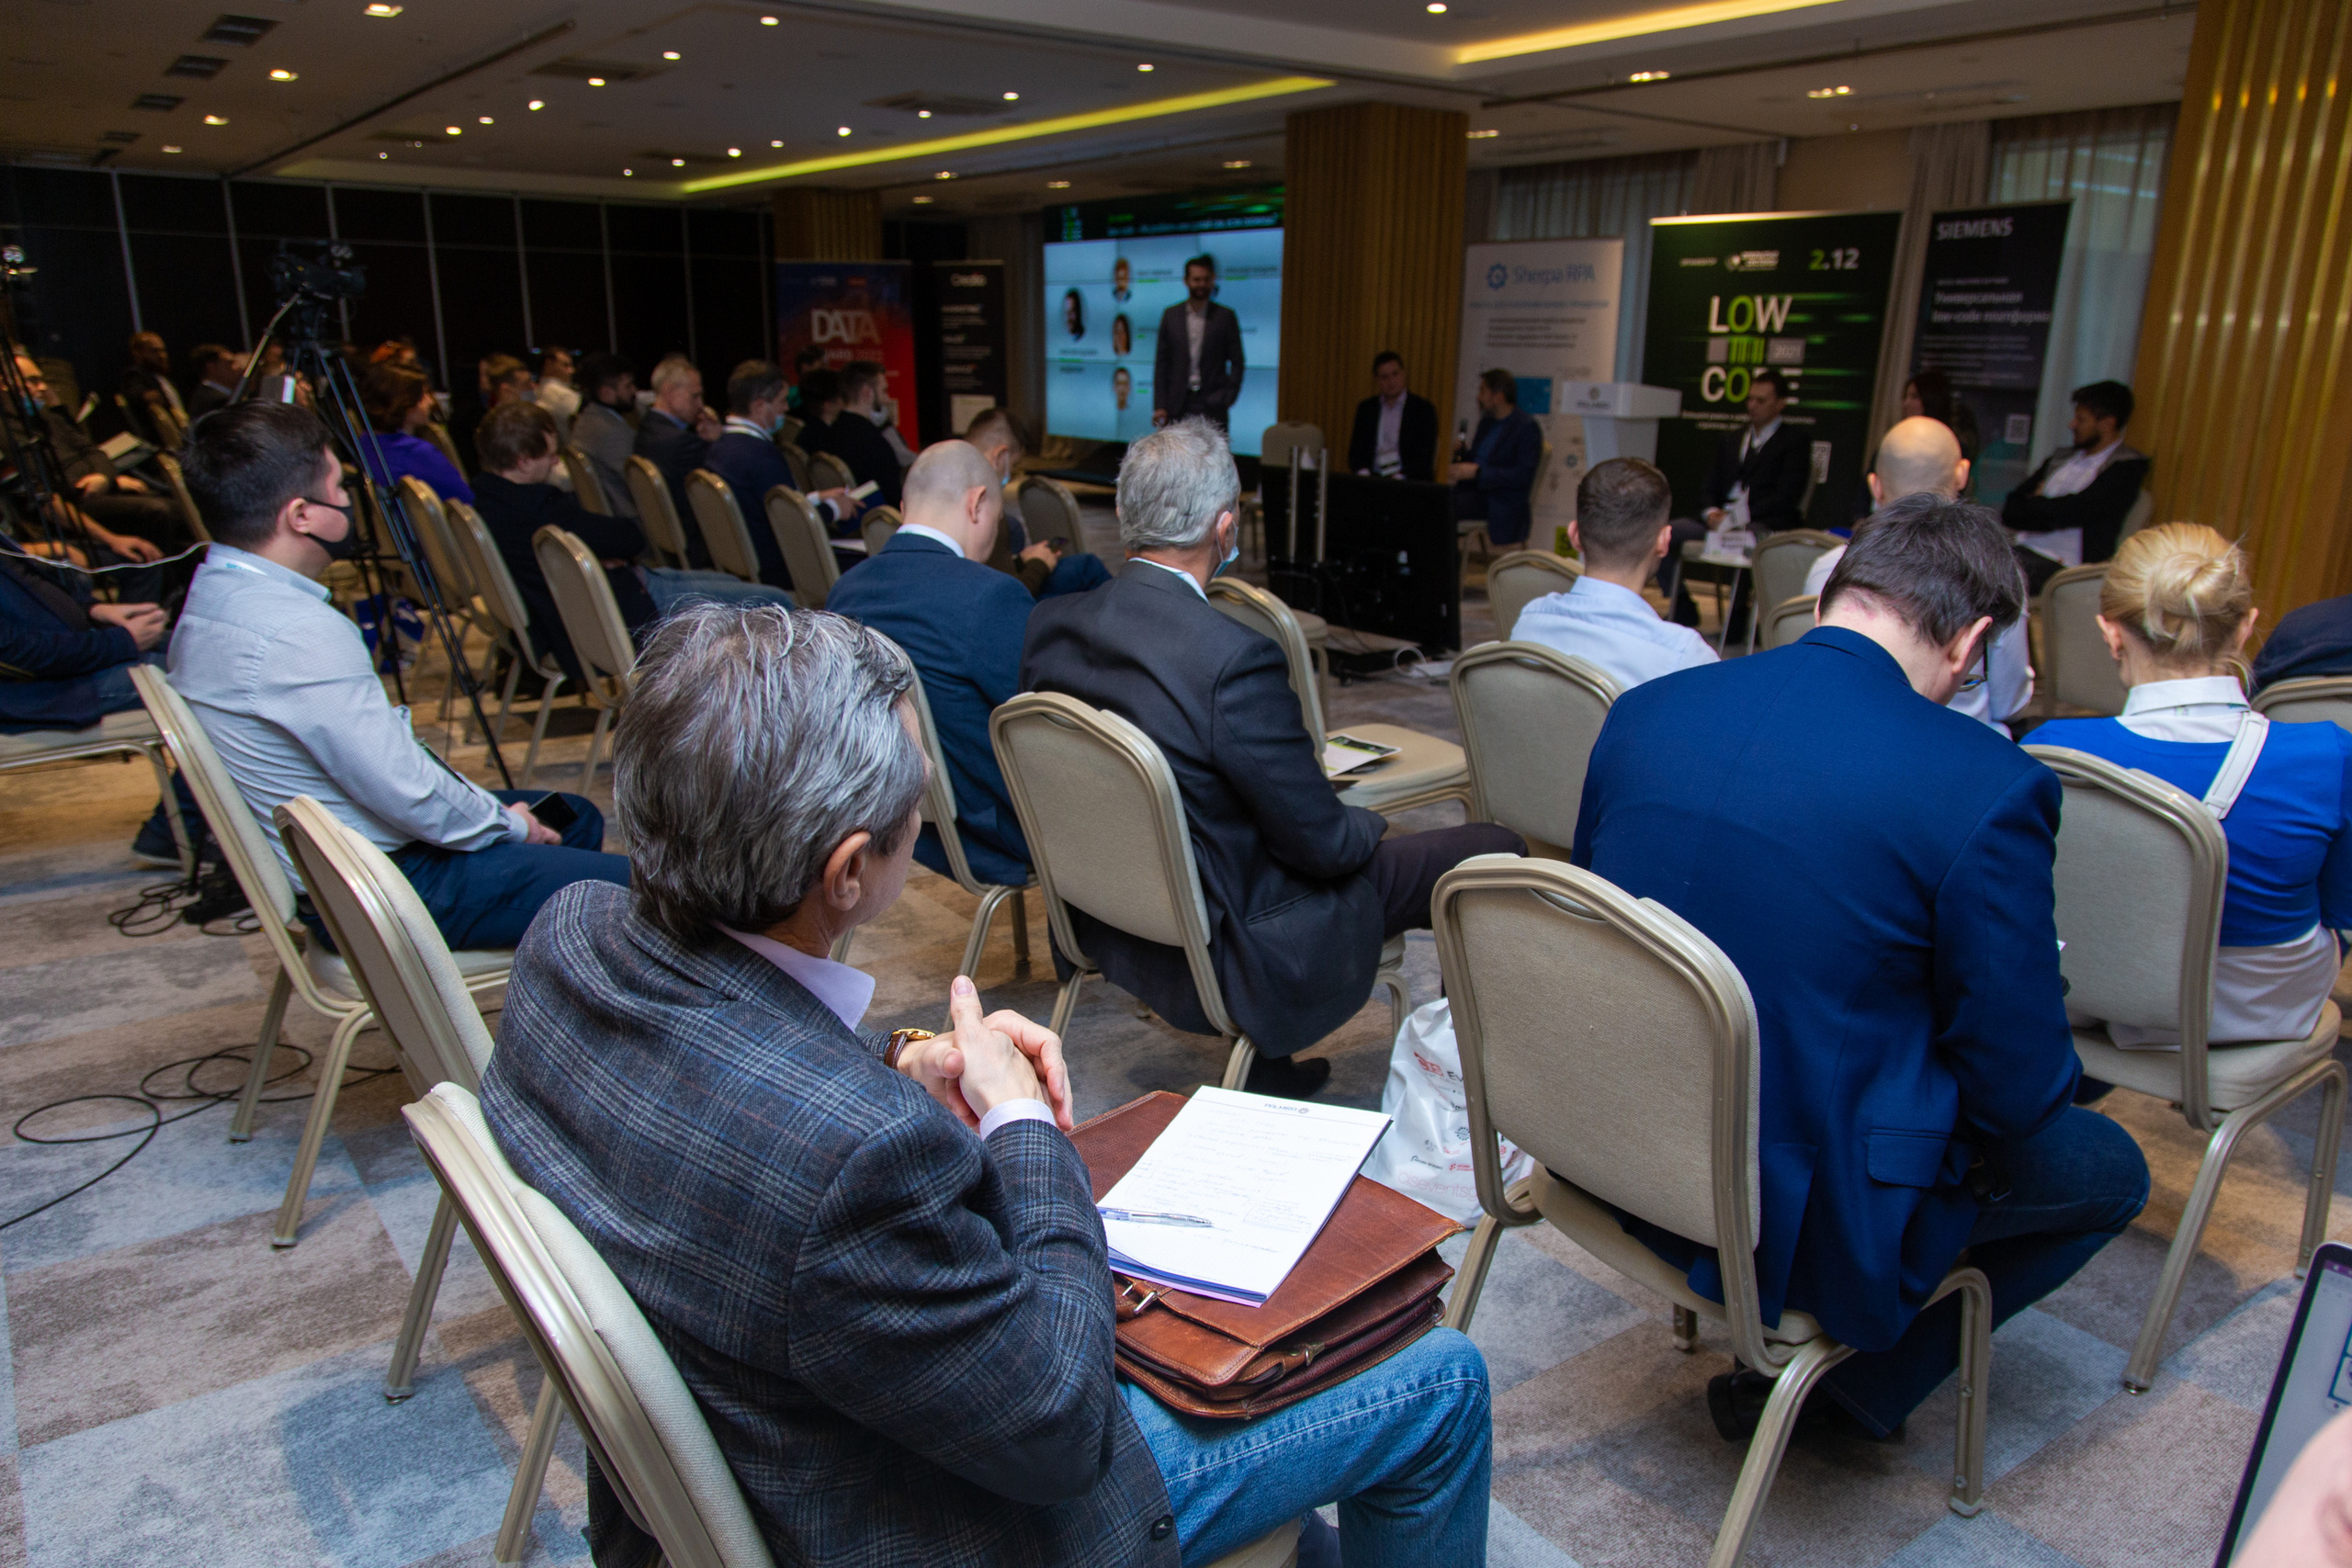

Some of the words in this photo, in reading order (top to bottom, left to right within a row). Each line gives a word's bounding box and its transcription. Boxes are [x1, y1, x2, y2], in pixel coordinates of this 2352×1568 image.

[1937, 217, 2014, 241] SIEMENS
[1566, 263, 1596, 283] RPA
[1808, 248, 1860, 270] 2.12
[811, 309, 881, 345] DATA
[1708, 295, 1792, 333] LOW
[1702, 366, 1803, 402] COE
